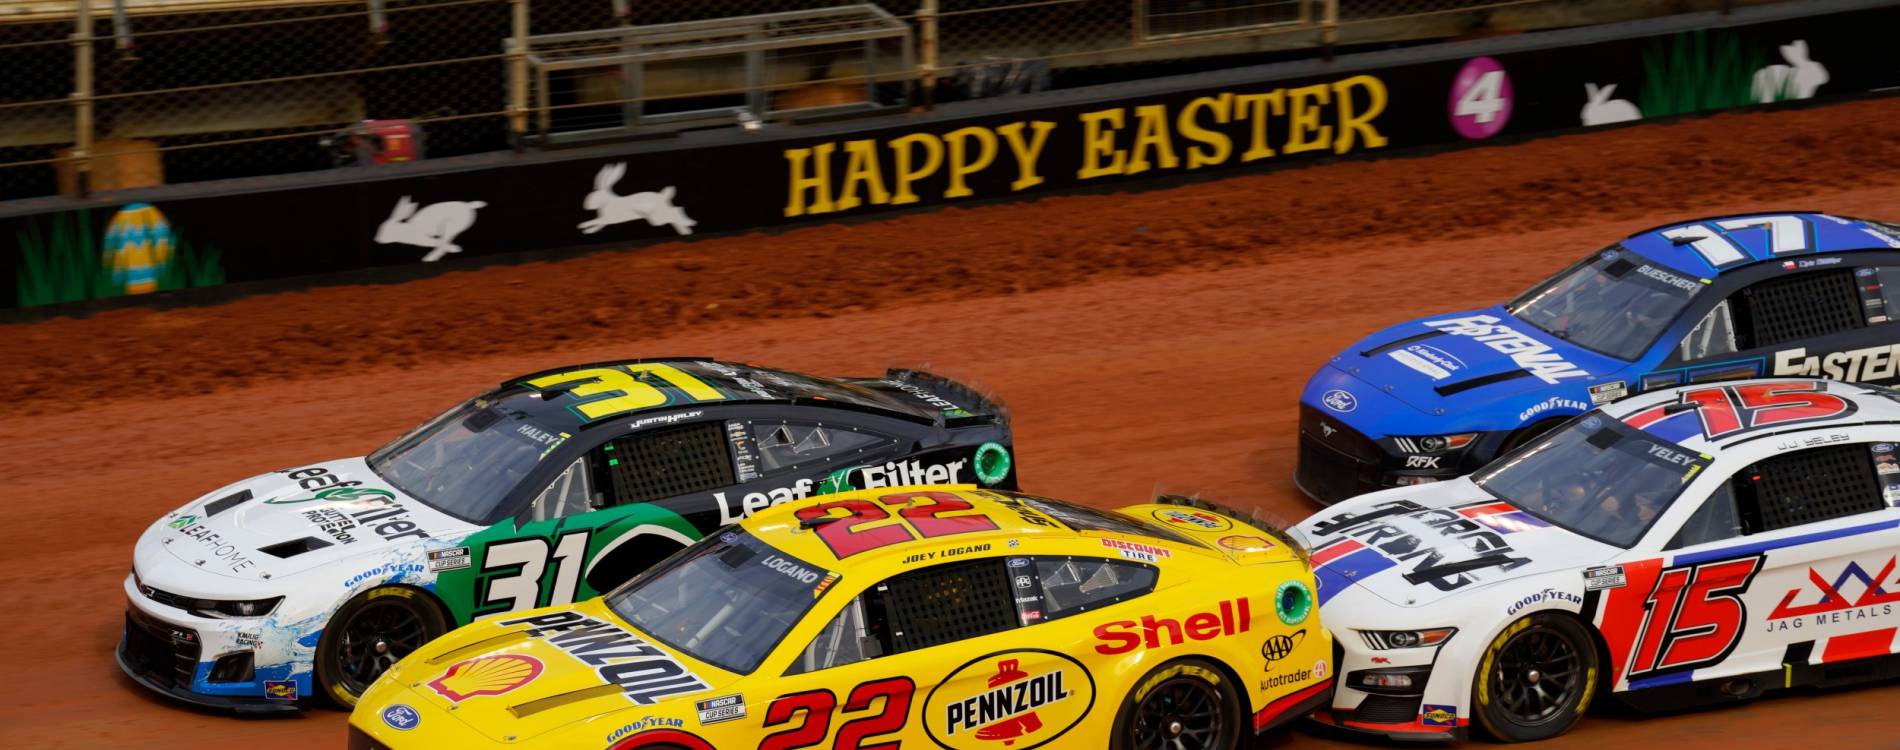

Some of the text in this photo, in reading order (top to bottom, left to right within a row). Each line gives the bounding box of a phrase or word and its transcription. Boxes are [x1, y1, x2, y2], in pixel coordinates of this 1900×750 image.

[1455, 70, 1506, 123] 4
[784, 75, 1388, 217] HAPPY EASTER
[1661, 216, 1805, 267] 17
[1637, 264, 1698, 291] BUESCHER
[1423, 315, 1591, 385] FASTENAL
[527, 362, 727, 420] 31
[1324, 391, 1356, 411] Ford
[1520, 396, 1588, 422] GOODYEAR
[1683, 382, 1858, 442] 15
[516, 424, 556, 446] HALEY
[1648, 444, 1697, 467] YELEY
[861, 457, 964, 490] Filter
[713, 478, 813, 526] Leaf
[794, 491, 1001, 560] 22
[902, 543, 991, 564] JOEY LOGANO
[1101, 537, 1171, 558] DISCOUNT
[1124, 550, 1155, 562] TIRE
[344, 563, 424, 588] GOODYEAR
[476, 532, 590, 620] 31
[761, 555, 819, 584] LOGANO
[1507, 588, 1582, 616] GOODYEAR
[1093, 597, 1251, 655] Shell
[1627, 554, 1767, 680] 15
[1767, 605, 1892, 632] JAG METALS
[705, 706, 739, 719] CUP SERIES
[711, 697, 736, 708] NASCAR
[757, 676, 916, 750] 22
[947, 670, 1068, 736] PENNZOIL
[387, 706, 417, 728] Ford
[606, 715, 684, 743] GOODYEAR
